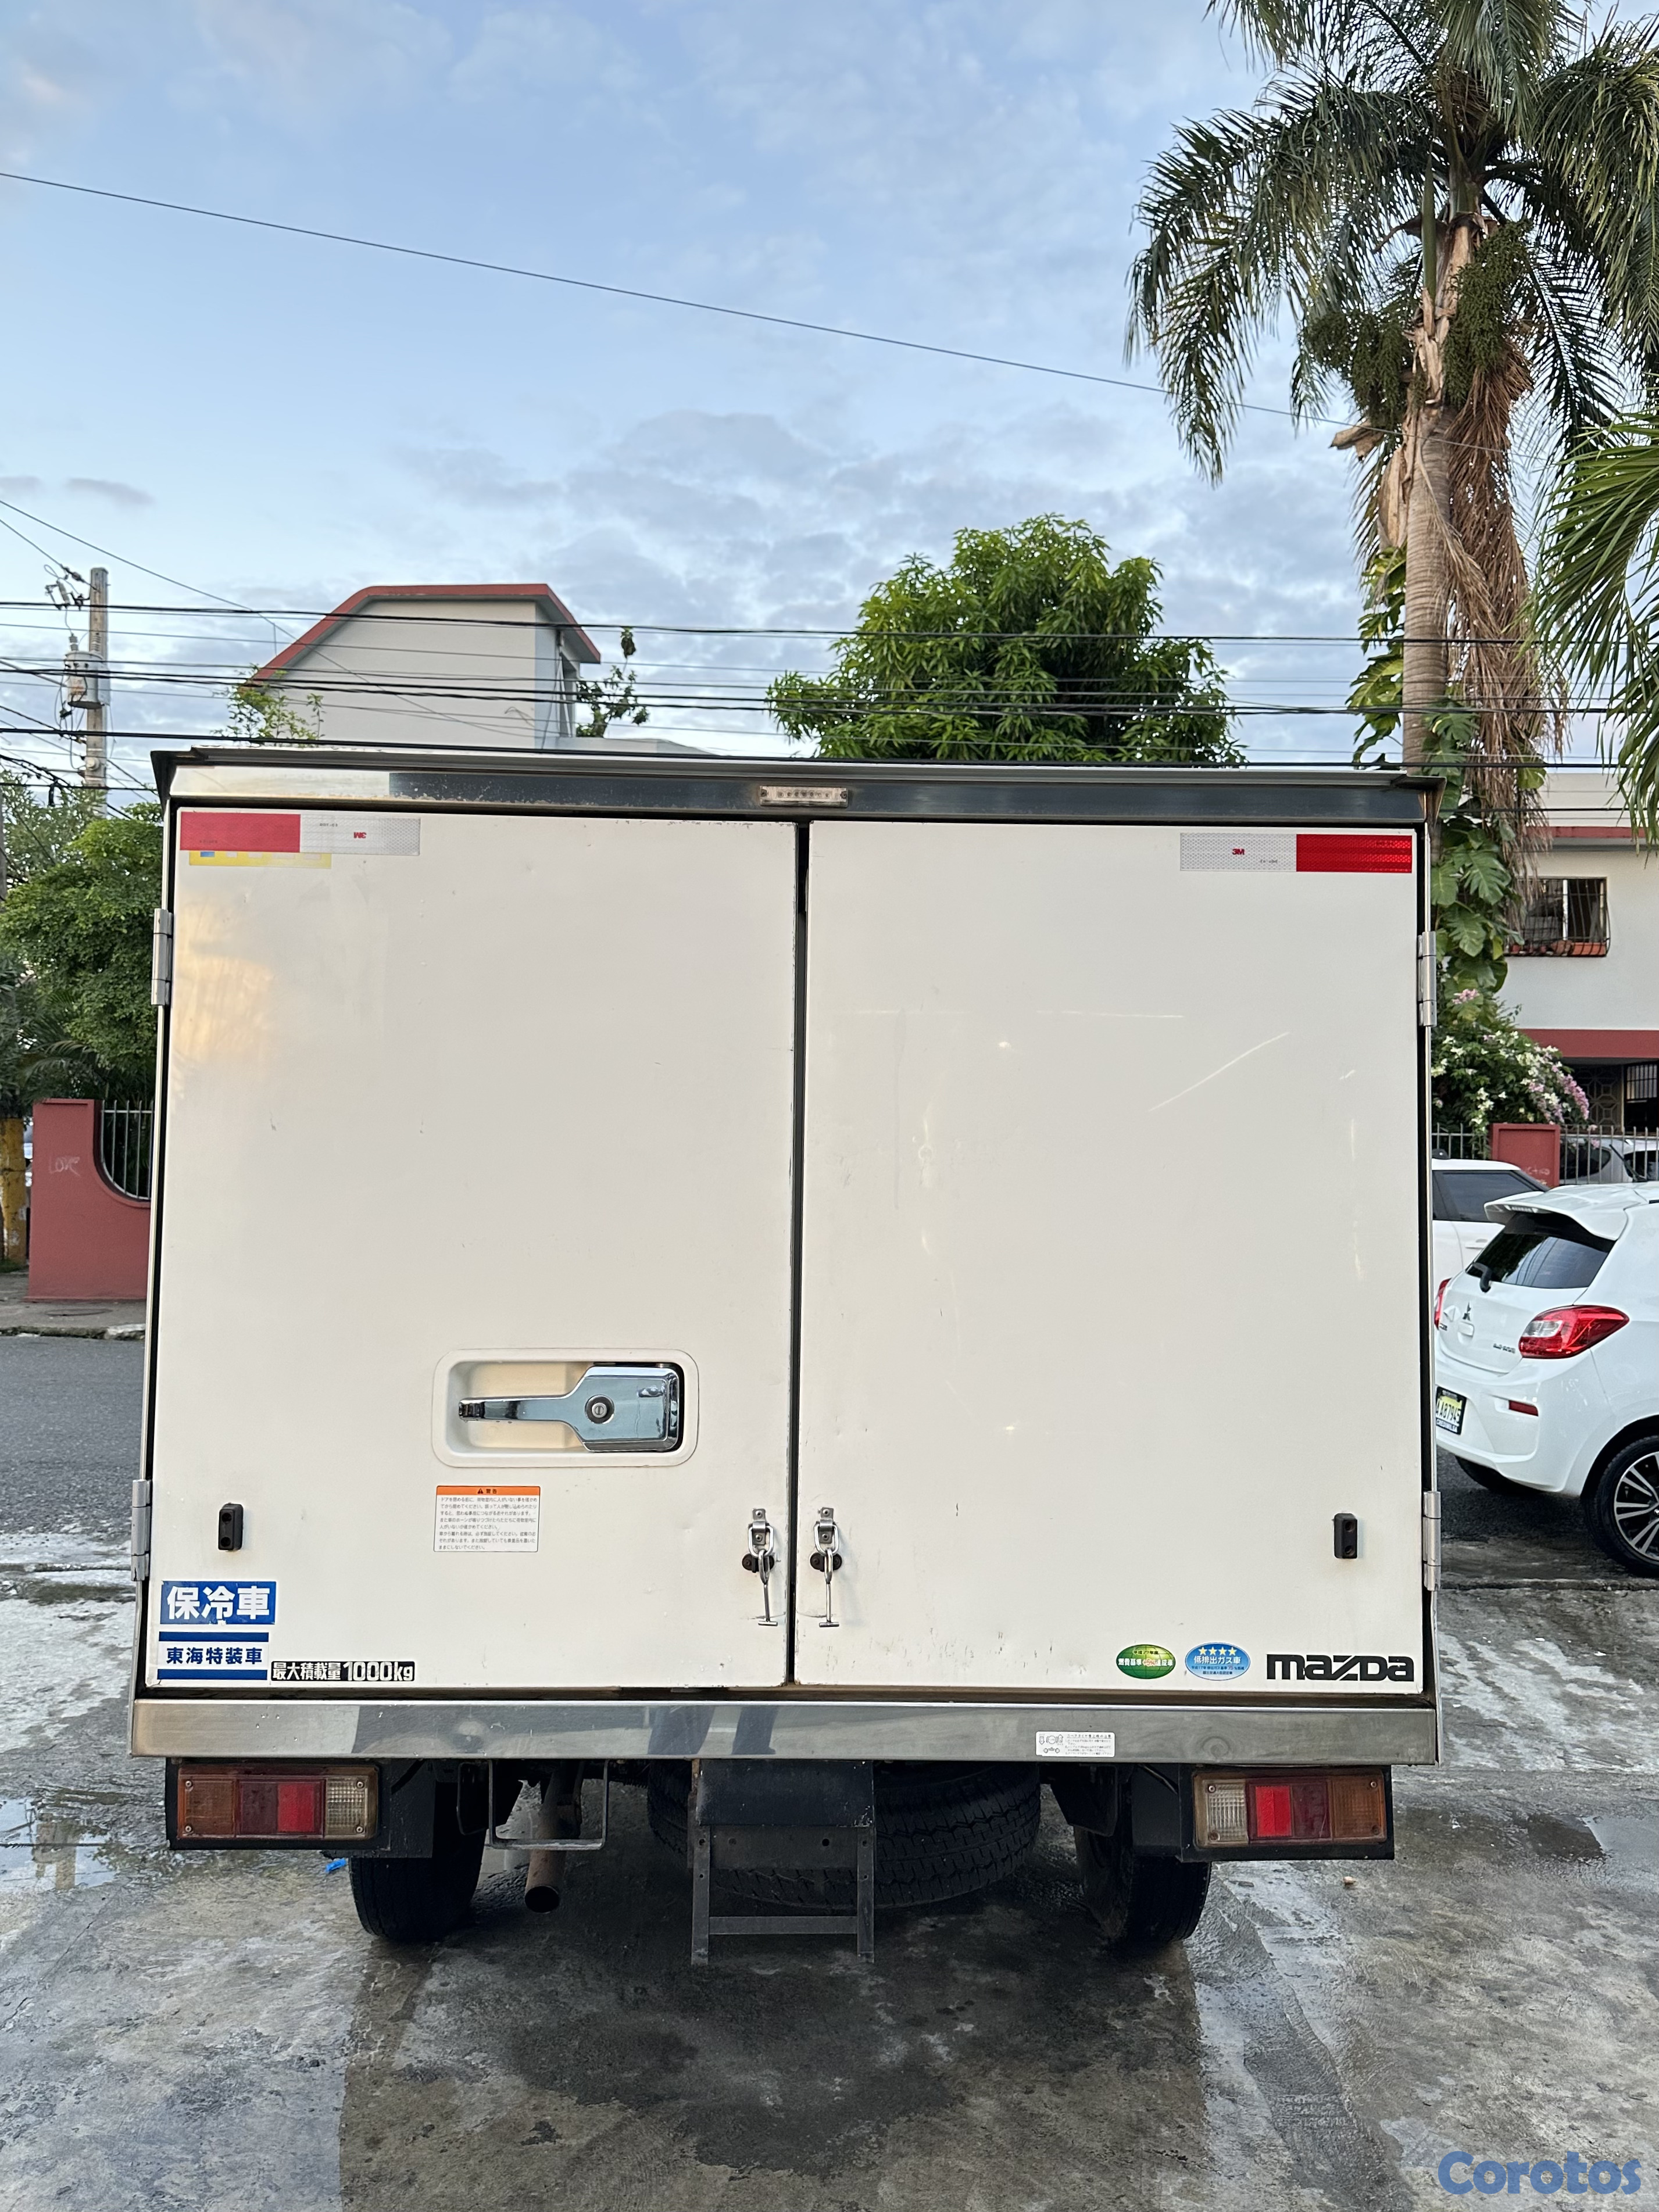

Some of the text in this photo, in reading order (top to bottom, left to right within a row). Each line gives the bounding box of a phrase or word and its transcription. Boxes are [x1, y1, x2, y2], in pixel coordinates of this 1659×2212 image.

[167, 1585, 270, 1620] 保冷車
[166, 1647, 262, 1665] 東海特装車
[1194, 1656, 1242, 1665] 低排出ガス車
